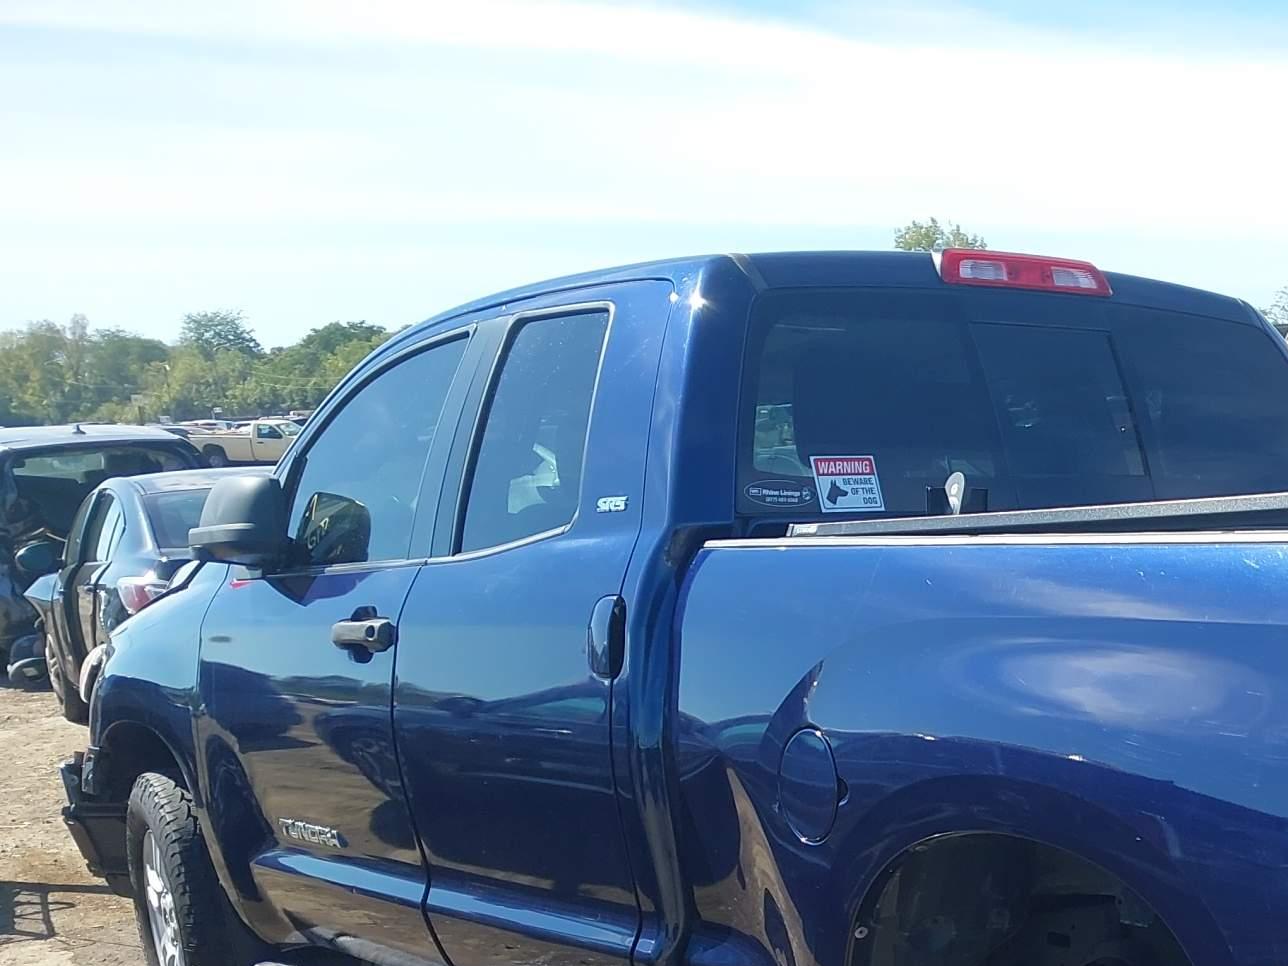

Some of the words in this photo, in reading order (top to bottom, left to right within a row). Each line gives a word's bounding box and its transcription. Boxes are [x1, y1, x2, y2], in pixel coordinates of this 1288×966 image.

[817, 461, 870, 474] WARNING
[842, 478, 875, 486] BEWARE
[851, 488, 860, 496] OF
[861, 487, 876, 495] THE
[279, 817, 342, 848] TUNDRA
